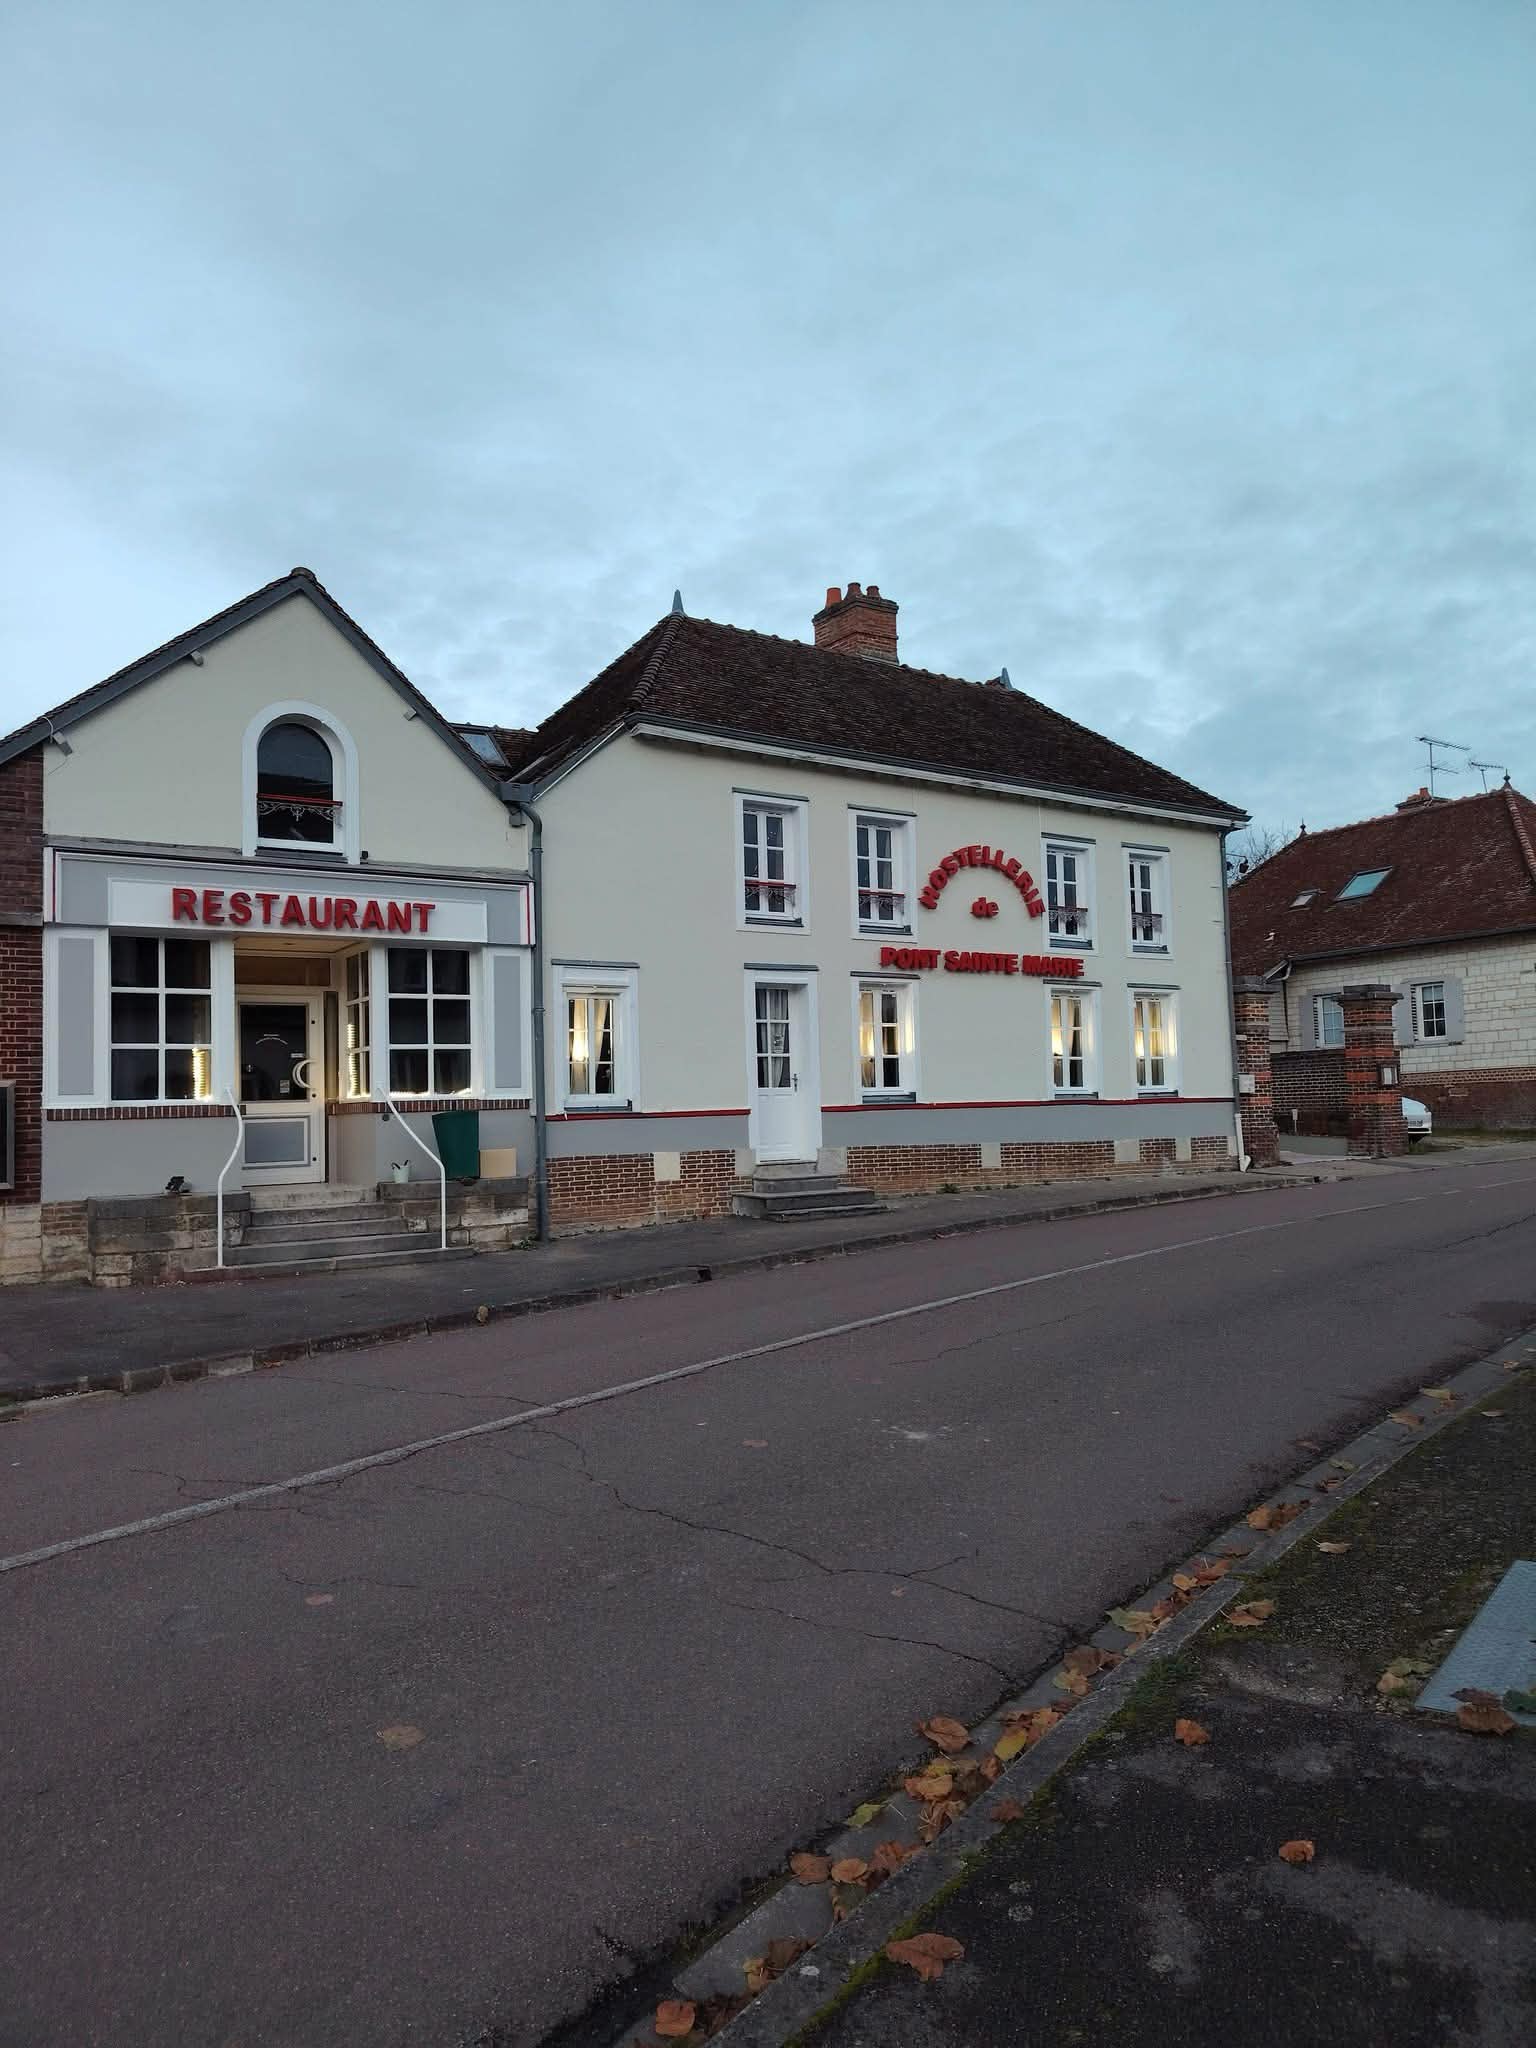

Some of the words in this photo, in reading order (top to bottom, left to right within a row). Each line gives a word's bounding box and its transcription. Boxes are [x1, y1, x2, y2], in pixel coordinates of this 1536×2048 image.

[918, 845, 1046, 918] HOSTELLERIE
[172, 887, 436, 933] RESTAURANT
[970, 897, 1000, 918] de
[880, 946, 941, 970] PONT
[944, 949, 1018, 973] SAINTE
[1022, 955, 1084, 977] MARIE
